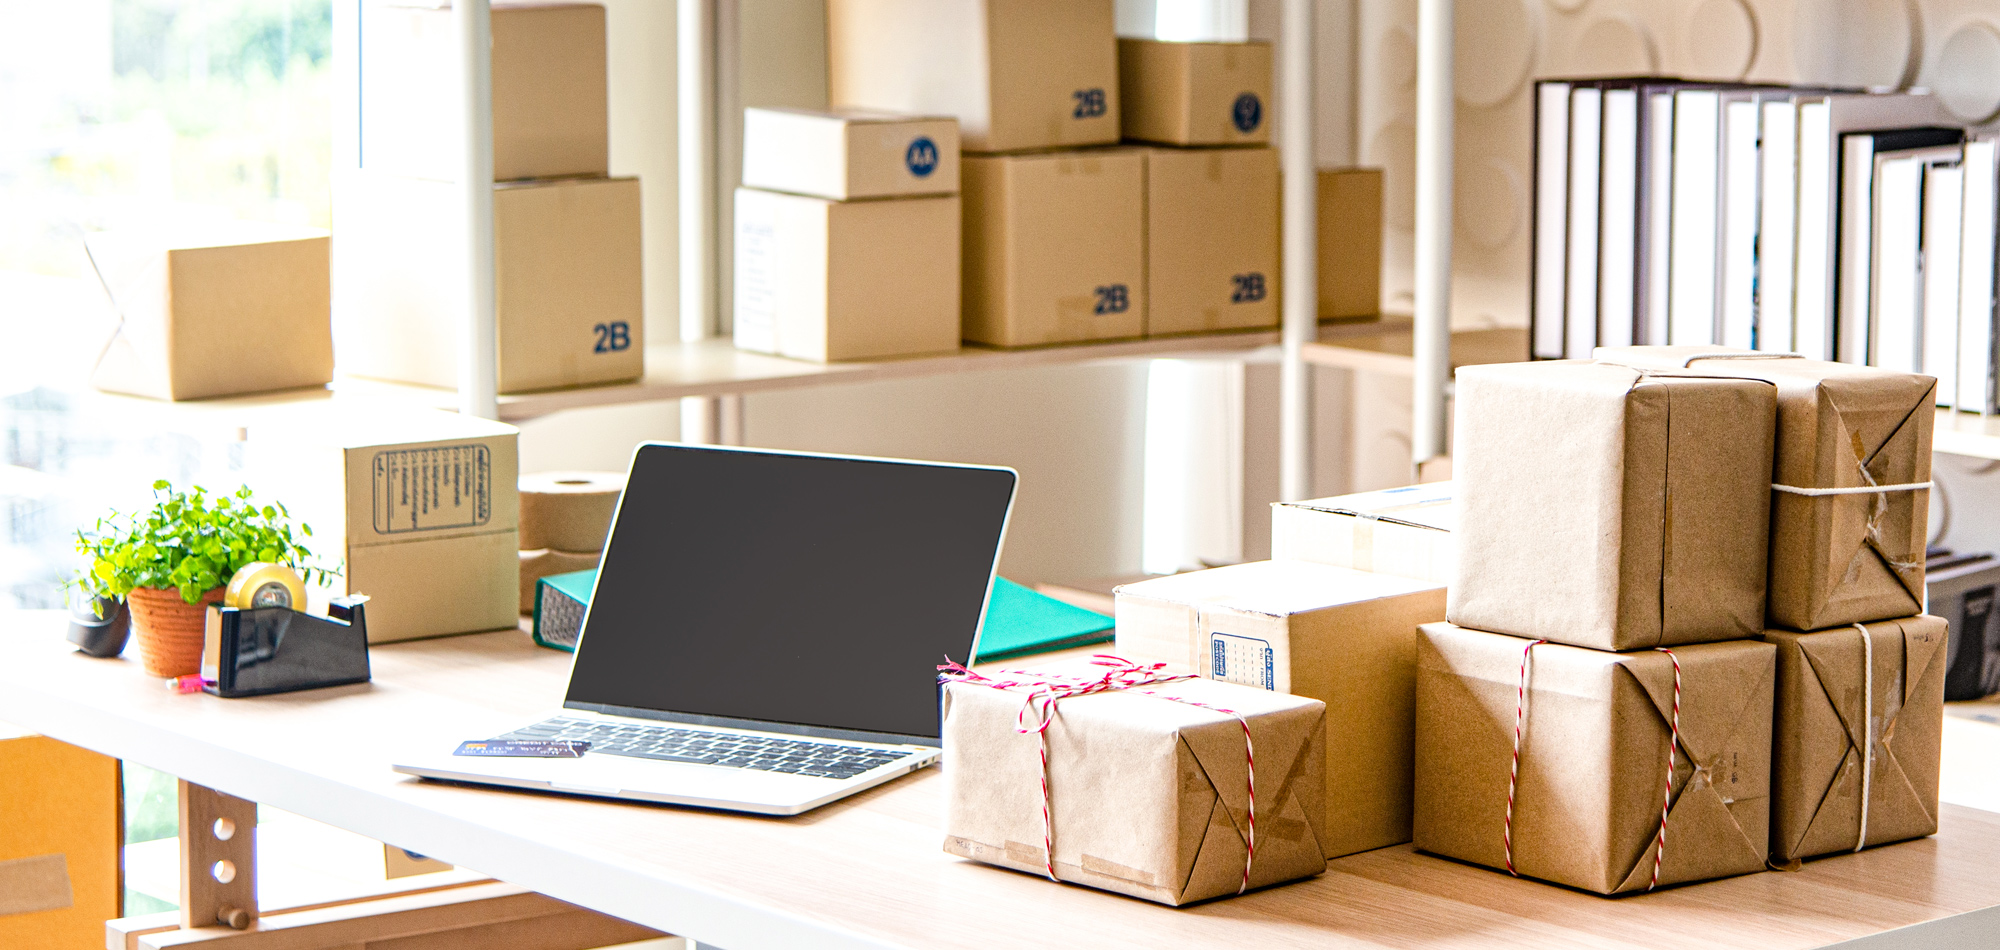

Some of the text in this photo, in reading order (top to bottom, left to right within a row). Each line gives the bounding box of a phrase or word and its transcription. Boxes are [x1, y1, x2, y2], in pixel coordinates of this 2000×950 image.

[1073, 88, 1107, 119] 2B
[1094, 283, 1129, 315] 2B
[1232, 273, 1266, 303] 2B
[594, 321, 631, 353] 2B
